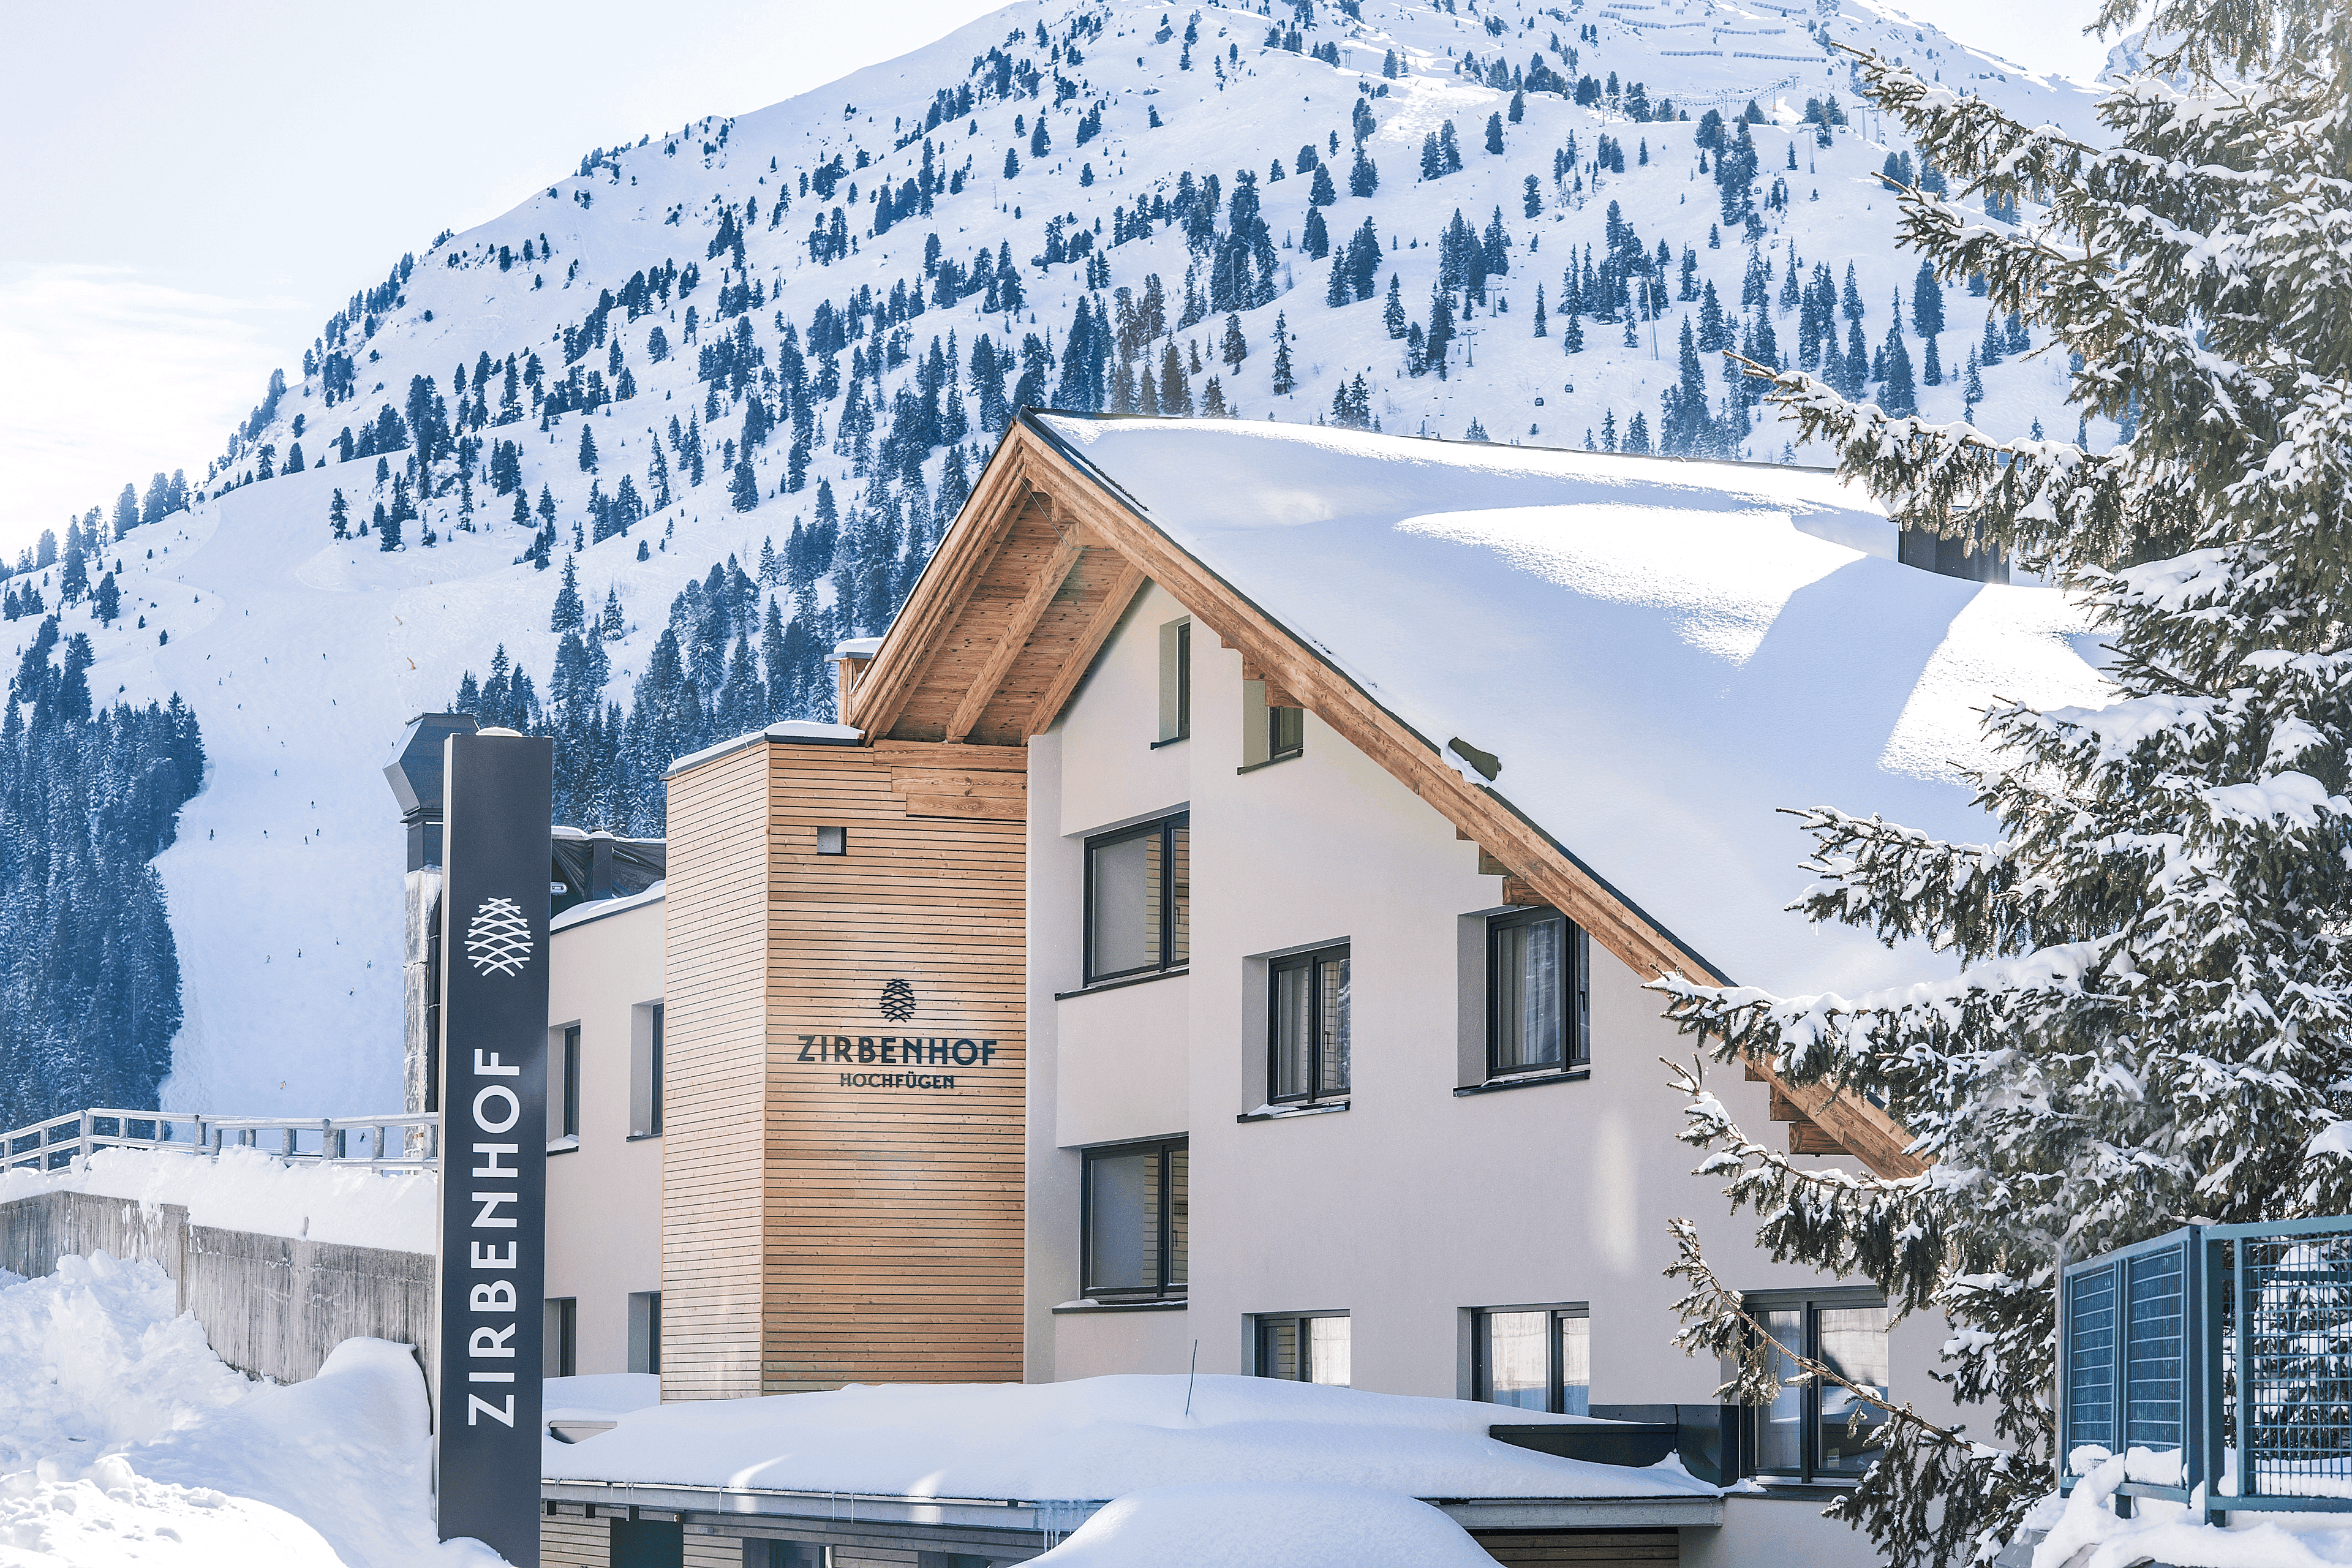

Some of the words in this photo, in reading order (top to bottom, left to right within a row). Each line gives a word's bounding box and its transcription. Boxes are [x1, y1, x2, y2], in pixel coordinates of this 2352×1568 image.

[797, 1035, 997, 1066] ZIRBENHOF
[840, 1071, 954, 1089] HOCHFÜGEN
[468, 1048, 520, 1428] ZIRBENHOF
